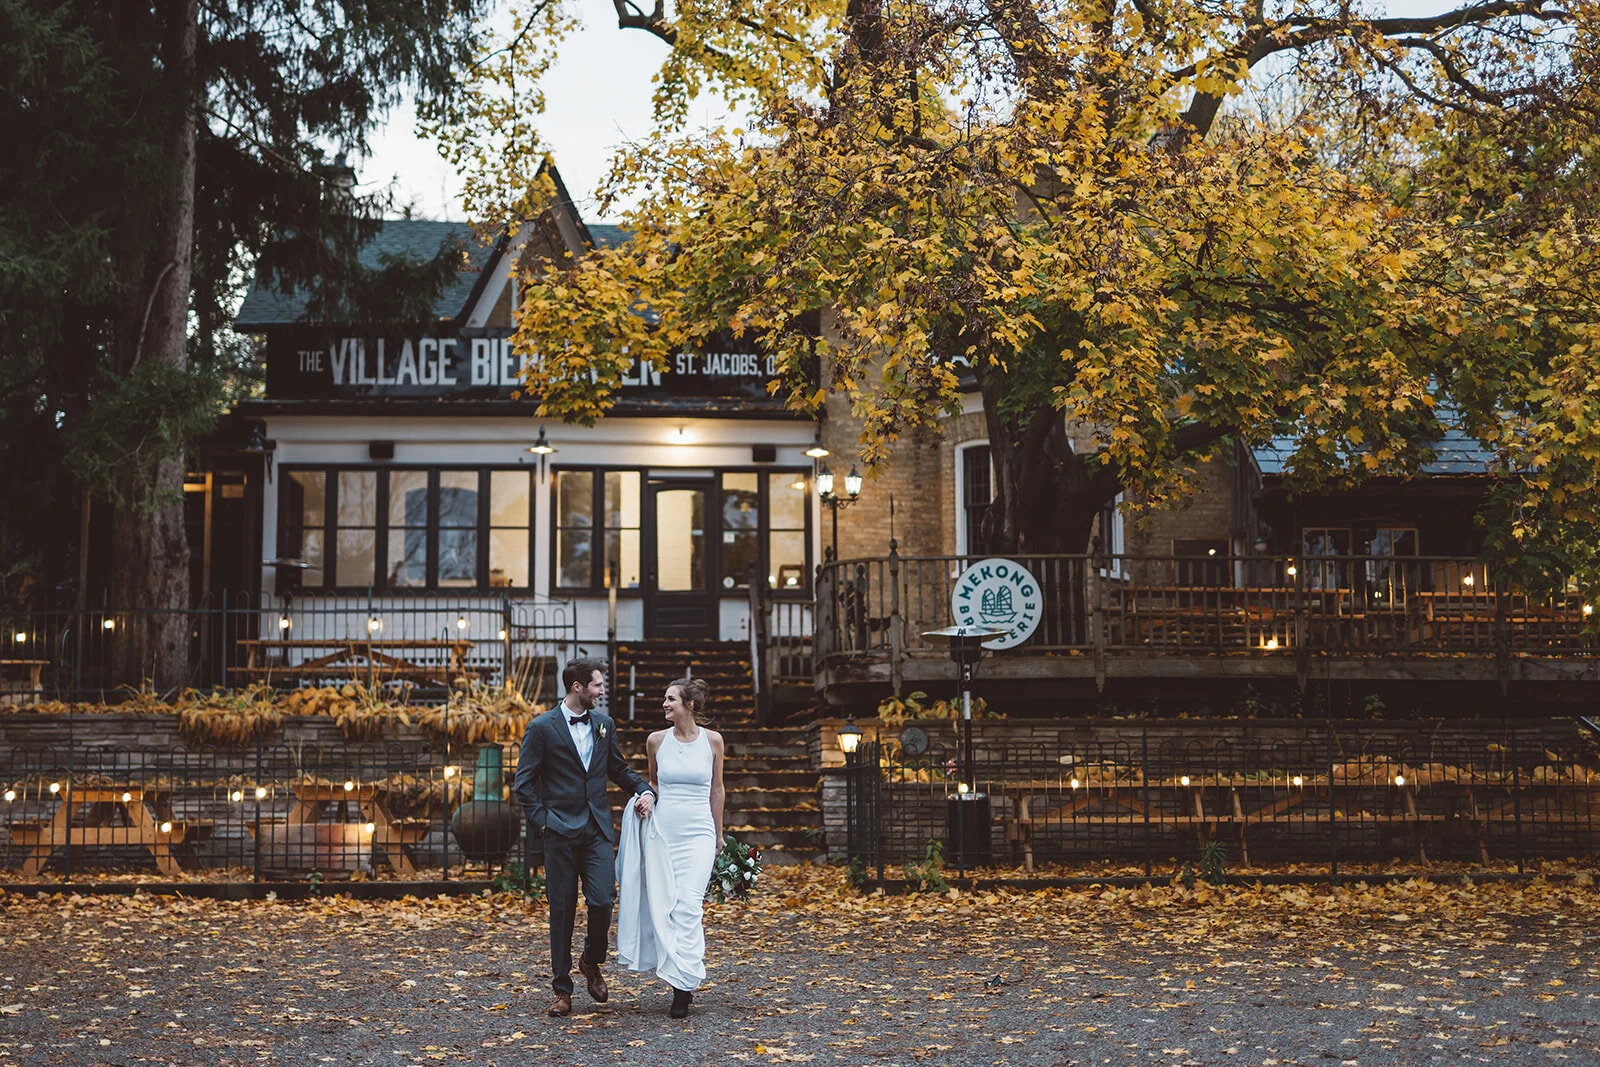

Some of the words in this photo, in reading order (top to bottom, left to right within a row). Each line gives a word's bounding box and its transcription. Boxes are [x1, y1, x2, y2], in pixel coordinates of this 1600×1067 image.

[297, 351, 324, 372] THE
[329, 337, 458, 386] VILLAGE
[676, 353, 697, 375] ST.
[702, 353, 763, 377] JACOBS,
[958, 565, 1034, 600] MEKONG
[959, 602, 1036, 643] BRSERIE
